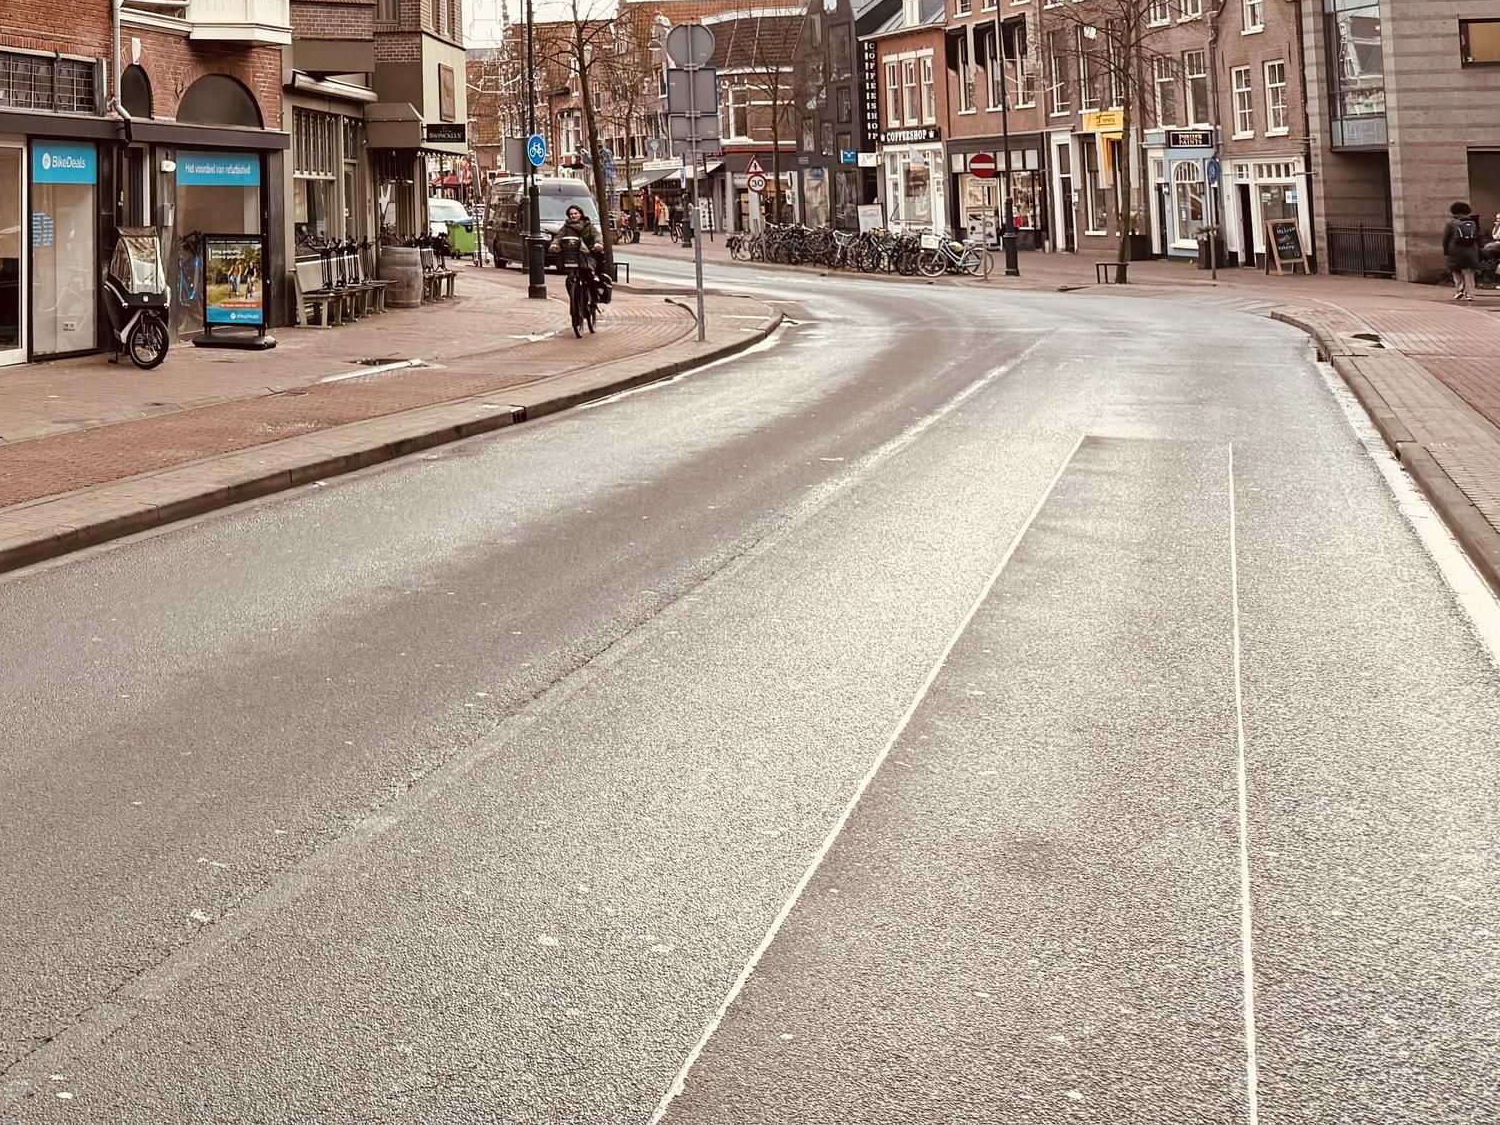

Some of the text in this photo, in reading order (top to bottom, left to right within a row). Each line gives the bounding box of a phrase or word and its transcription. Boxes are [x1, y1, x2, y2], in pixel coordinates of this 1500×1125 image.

[886, 129, 927, 142] COFFEESHOP
[52, 155, 85, 169] BikeDeals
[185, 162, 194, 173] Het
[195, 163, 215, 174] voordeel
[216, 166, 224, 174] van
[751, 179, 764, 187] 30
